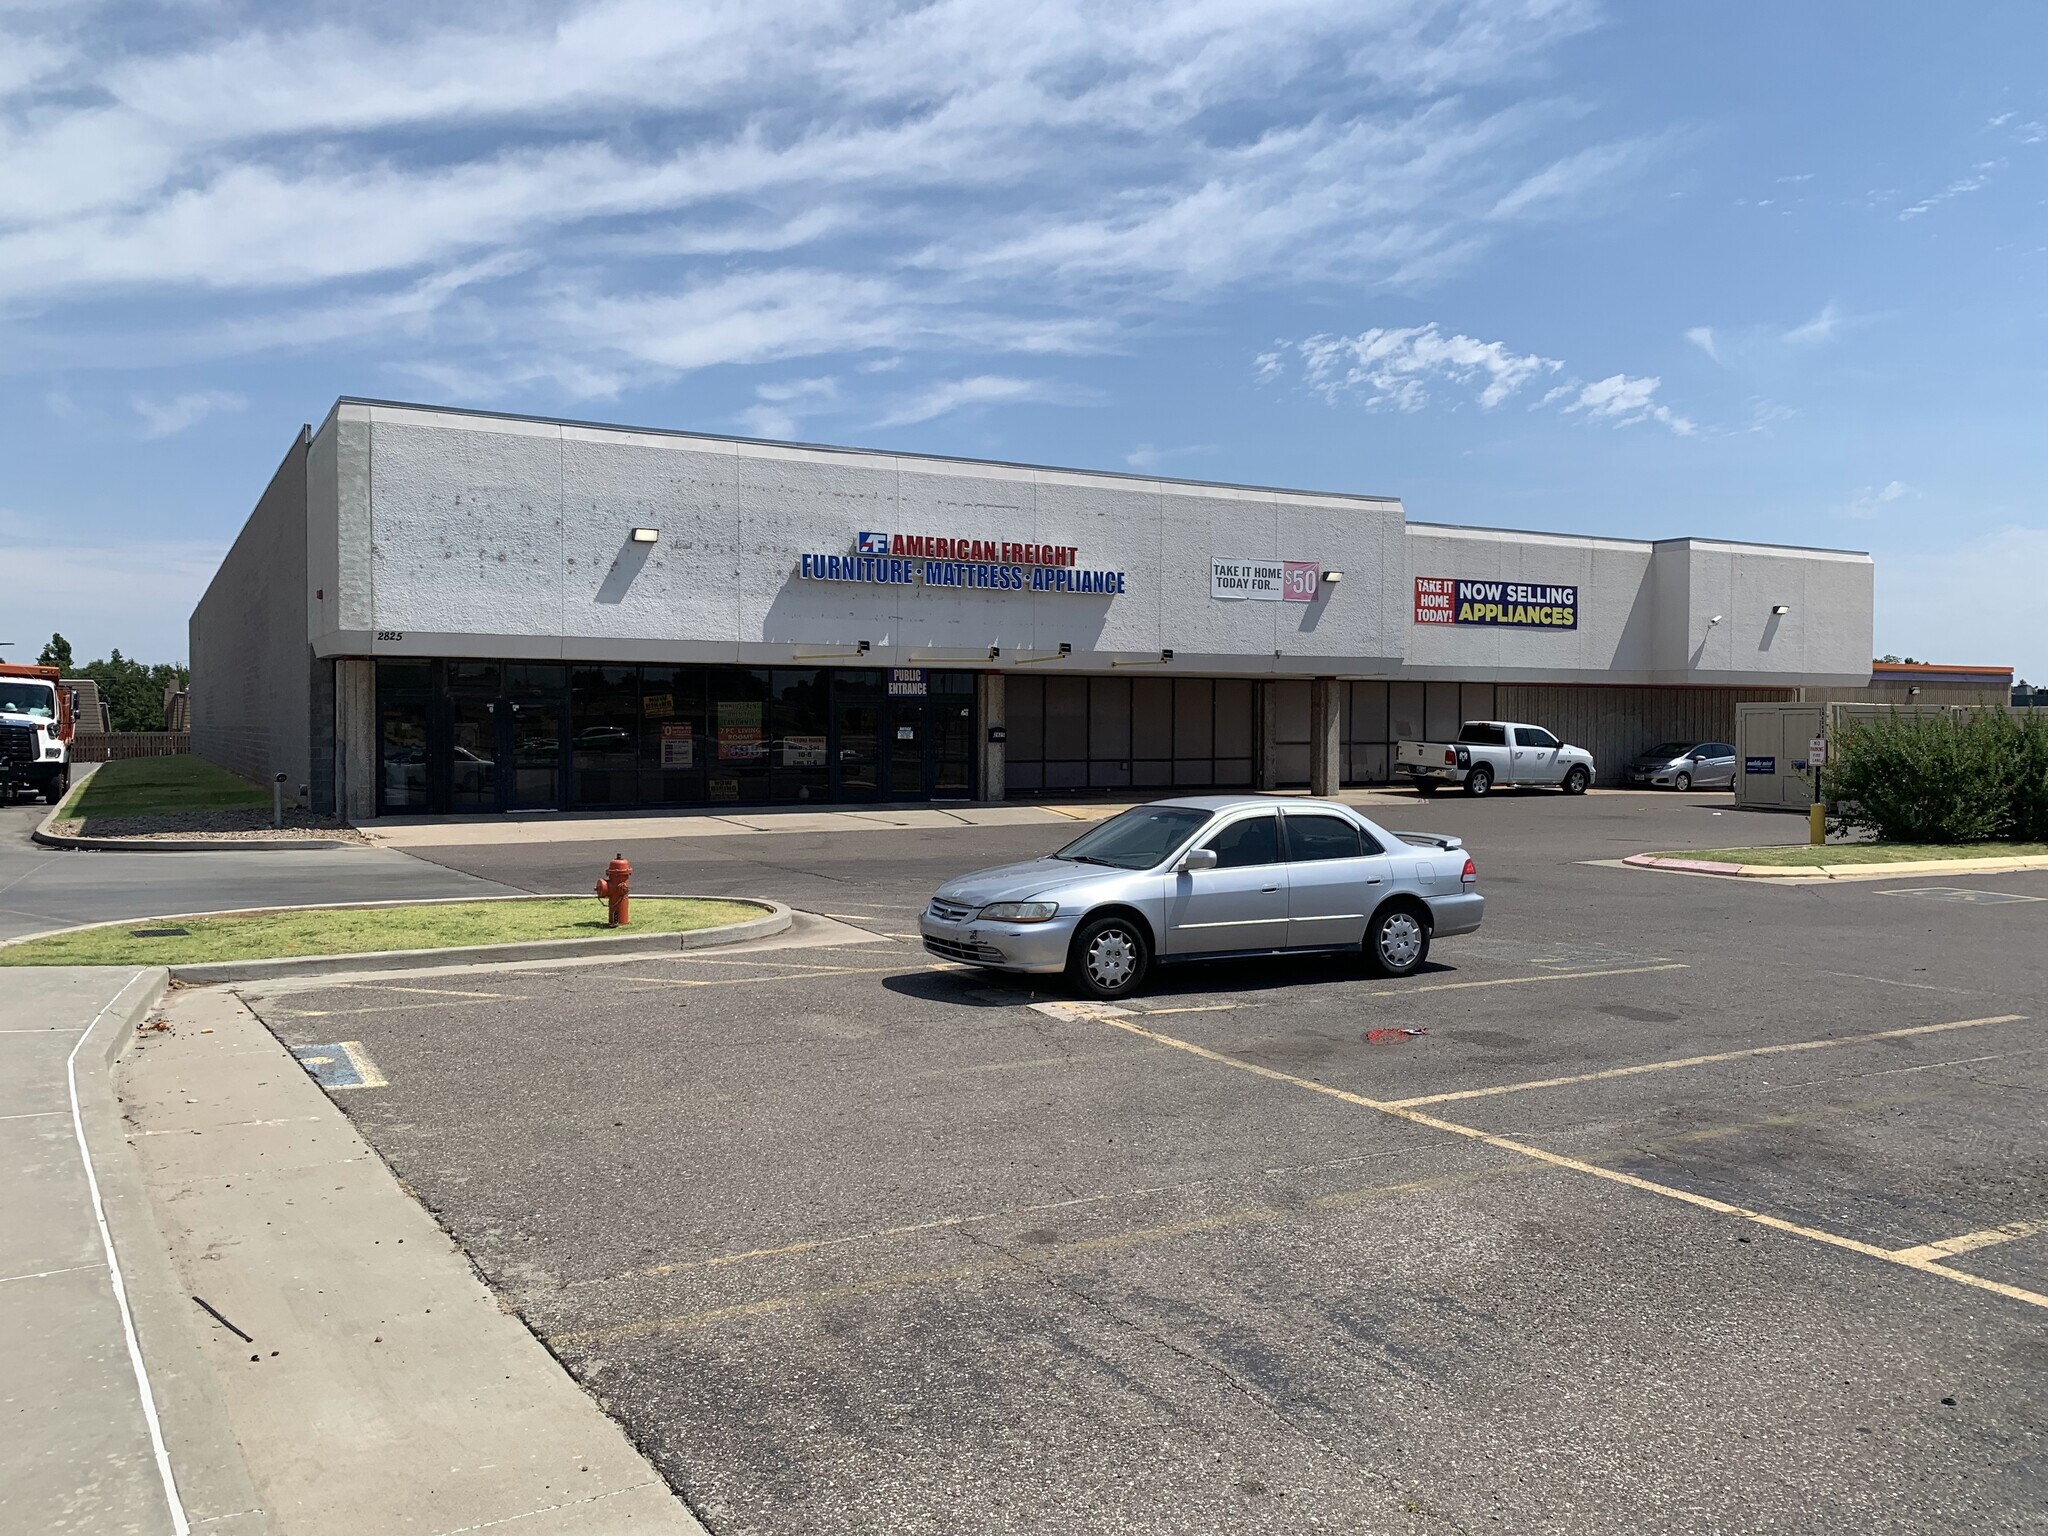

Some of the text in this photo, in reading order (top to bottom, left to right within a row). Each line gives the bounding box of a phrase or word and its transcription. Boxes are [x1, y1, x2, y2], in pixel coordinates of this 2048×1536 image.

[892, 534, 996, 562] AMERICAN
[1001, 542, 1078, 567] FREIGHT
[801, 554, 1125, 594] FURNITURE MATTRESS APPLIANCE
[1213, 564, 1282, 579] TAKE IT HOME
[1216, 577, 1279, 591] TODAY FOR...
[1285, 568, 1316, 594] $50
[1416, 578, 1453, 594] TAKE IT
[1420, 594, 1450, 608] HOME
[1459, 582, 1574, 605] NOW SELLING
[1416, 608, 1453, 623] TODAY!
[1458, 602, 1574, 626] APPLIANCES
[377, 631, 403, 641] 2825
[893, 669, 921, 682] PUBLIC
[888, 682, 927, 695] ENTRANCE
